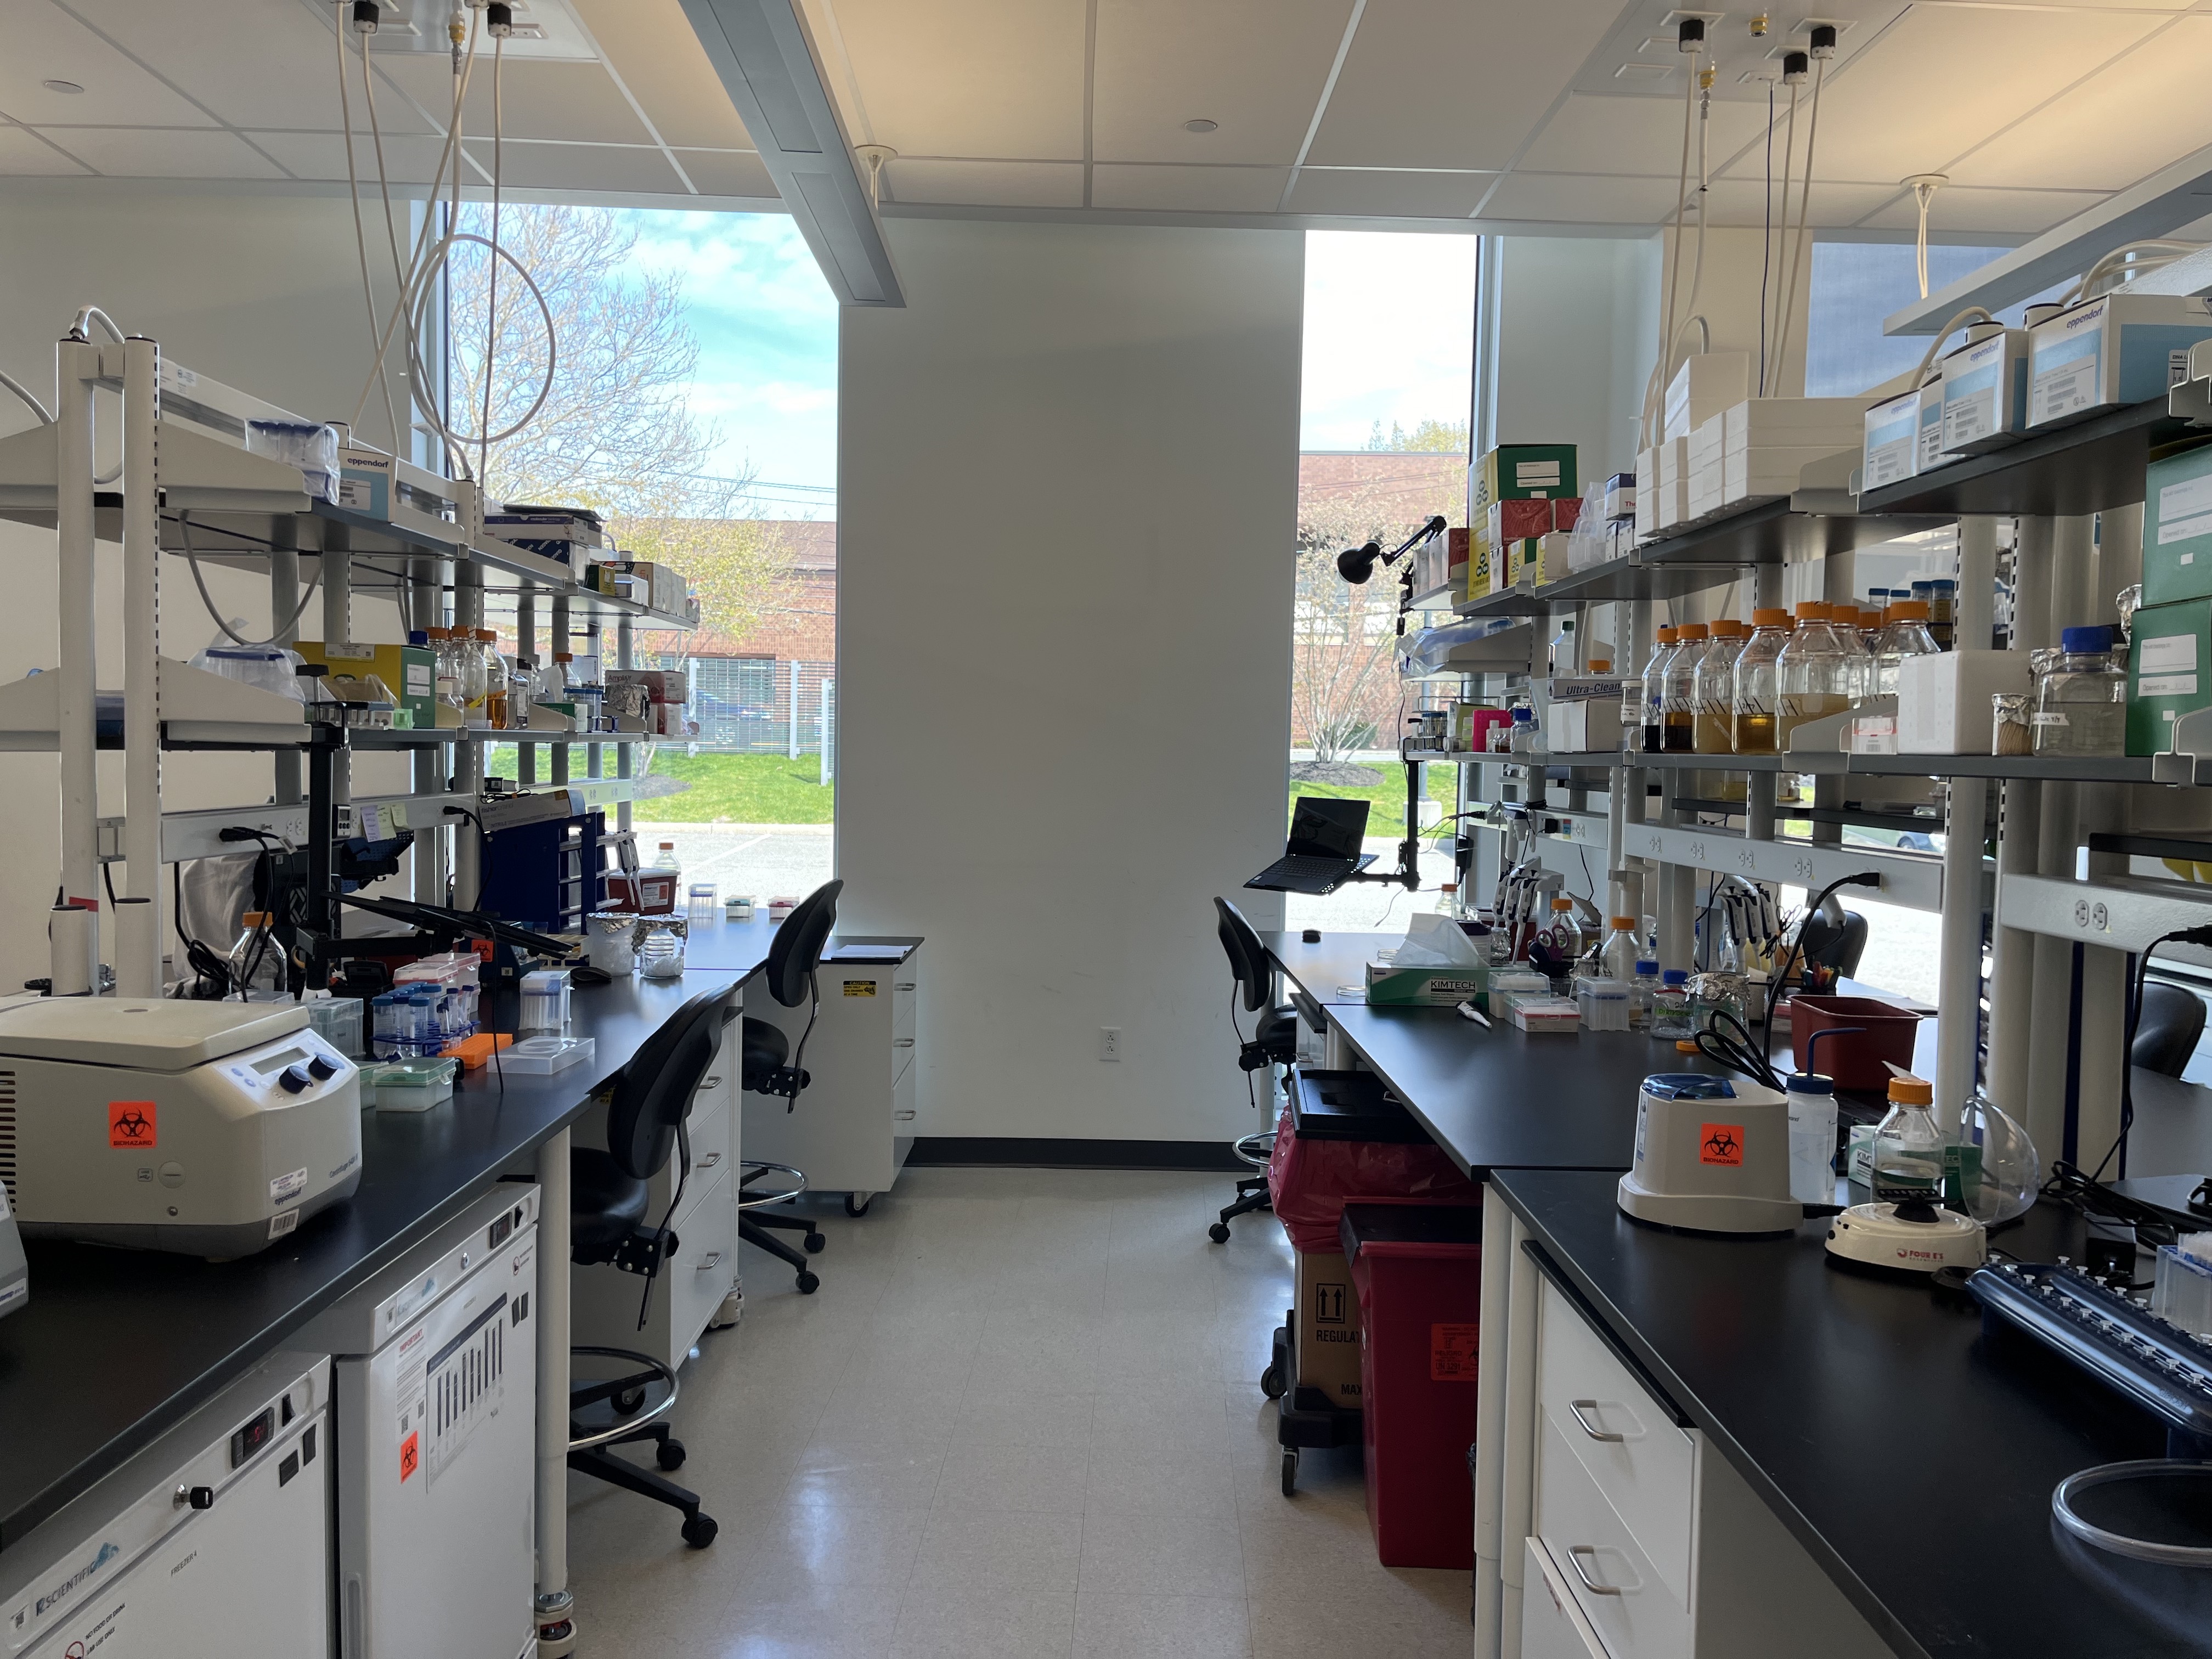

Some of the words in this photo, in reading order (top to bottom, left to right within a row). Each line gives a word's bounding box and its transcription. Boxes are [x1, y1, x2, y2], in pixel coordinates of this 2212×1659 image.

[2067, 305, 2103, 329] eppendorf
[1970, 340, 1999, 362] eppendorf
[347, 458, 388, 467] eppendorf
[1567, 682, 1621, 695] Ultra-Clean
[1431, 980, 1475, 989] KIMTECH
[400, 1328, 423, 1352] IMPORTANT
[171, 1554, 194, 1577] FREEZER
[45, 1560, 97, 1609] SCIENTIFIC
[86, 1630, 93, 1640] NO
[93, 1621, 106, 1634] FOOD
[87, 1644, 95, 1655] LAB
[95, 1636, 104, 1647] USE
[104, 1626, 116, 1640] ONLY
